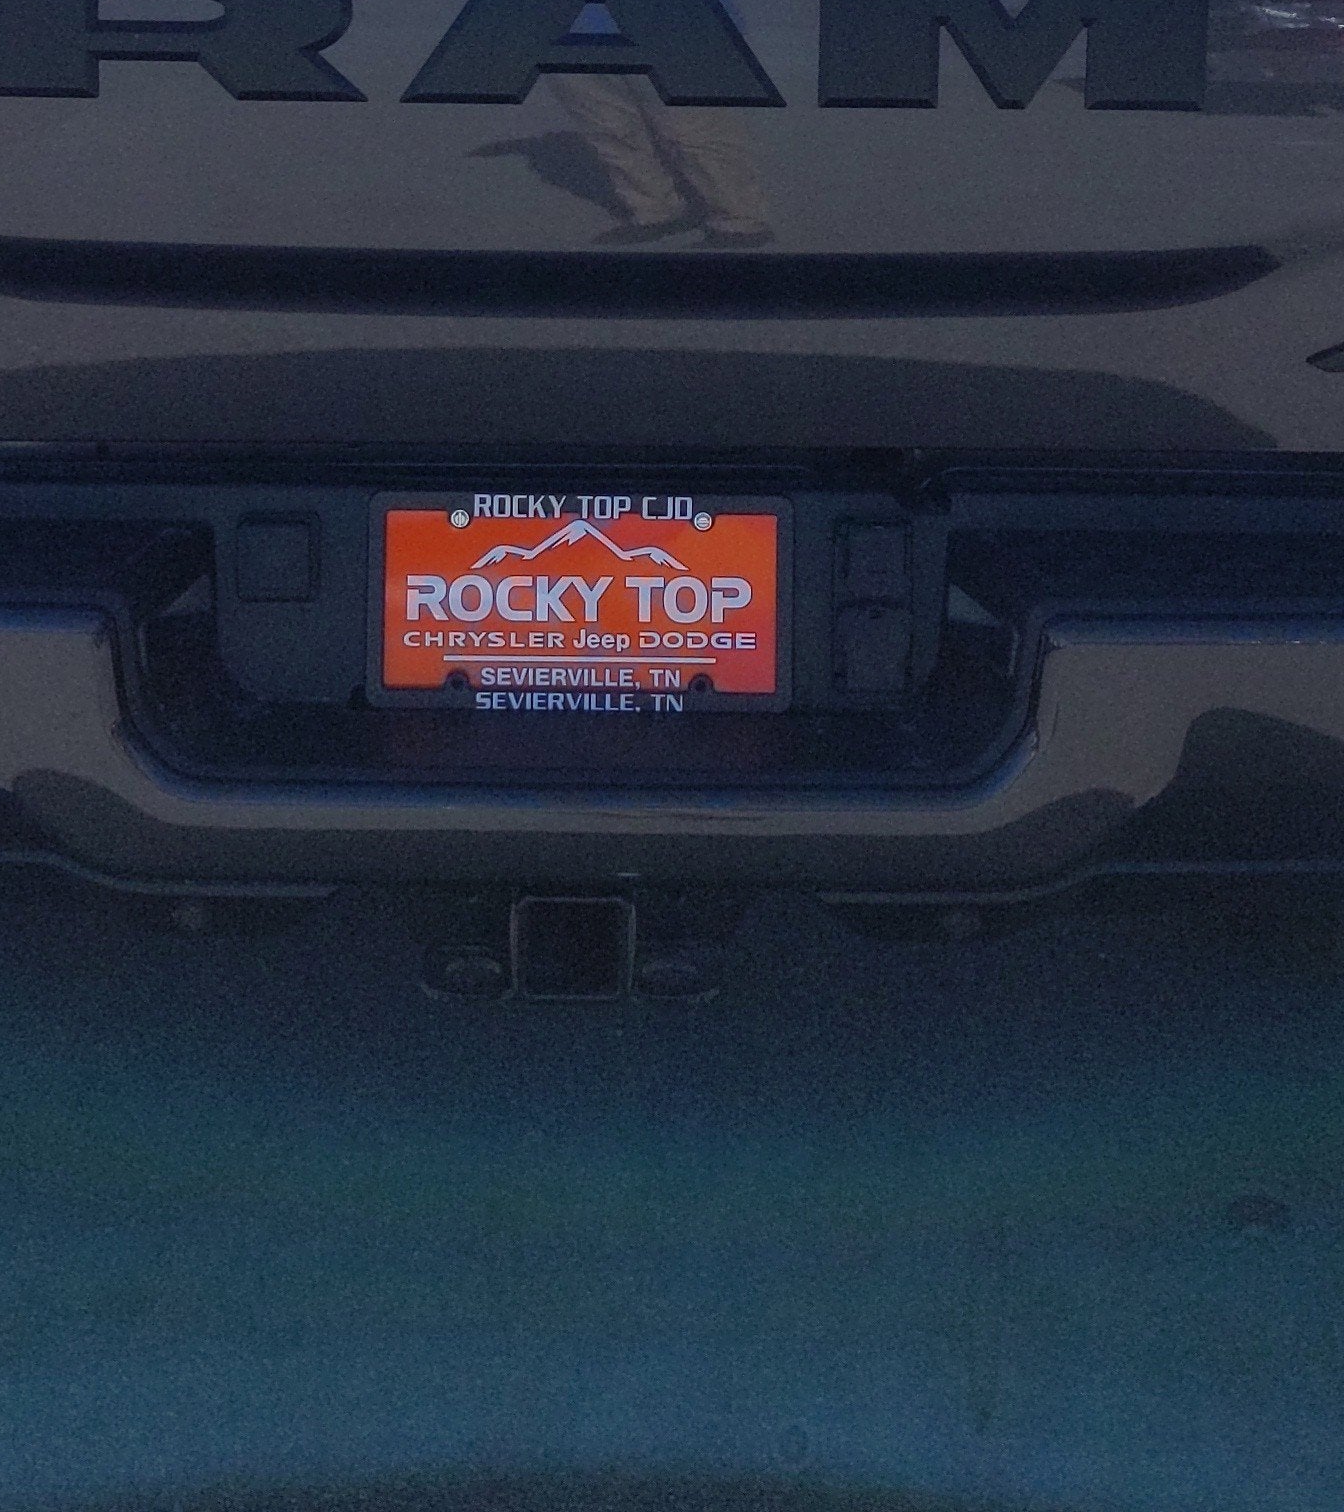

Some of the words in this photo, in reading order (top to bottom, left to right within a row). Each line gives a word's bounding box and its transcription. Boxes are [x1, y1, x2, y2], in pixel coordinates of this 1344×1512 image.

[473, 493, 566, 519] ROCKY
[577, 495, 631, 520] TOP
[642, 496, 693, 521] CJD
[405, 574, 614, 623] ROCKY
[625, 575, 752, 624] TOP
[403, 631, 565, 649] CHRYSLER
[572, 629, 631, 652] Jeep
[639, 631, 757, 650] DODGE
[480, 667, 641, 690] SEVIERVILLE,
[649, 668, 681, 688] TN
[650, 693, 684, 712] TN
